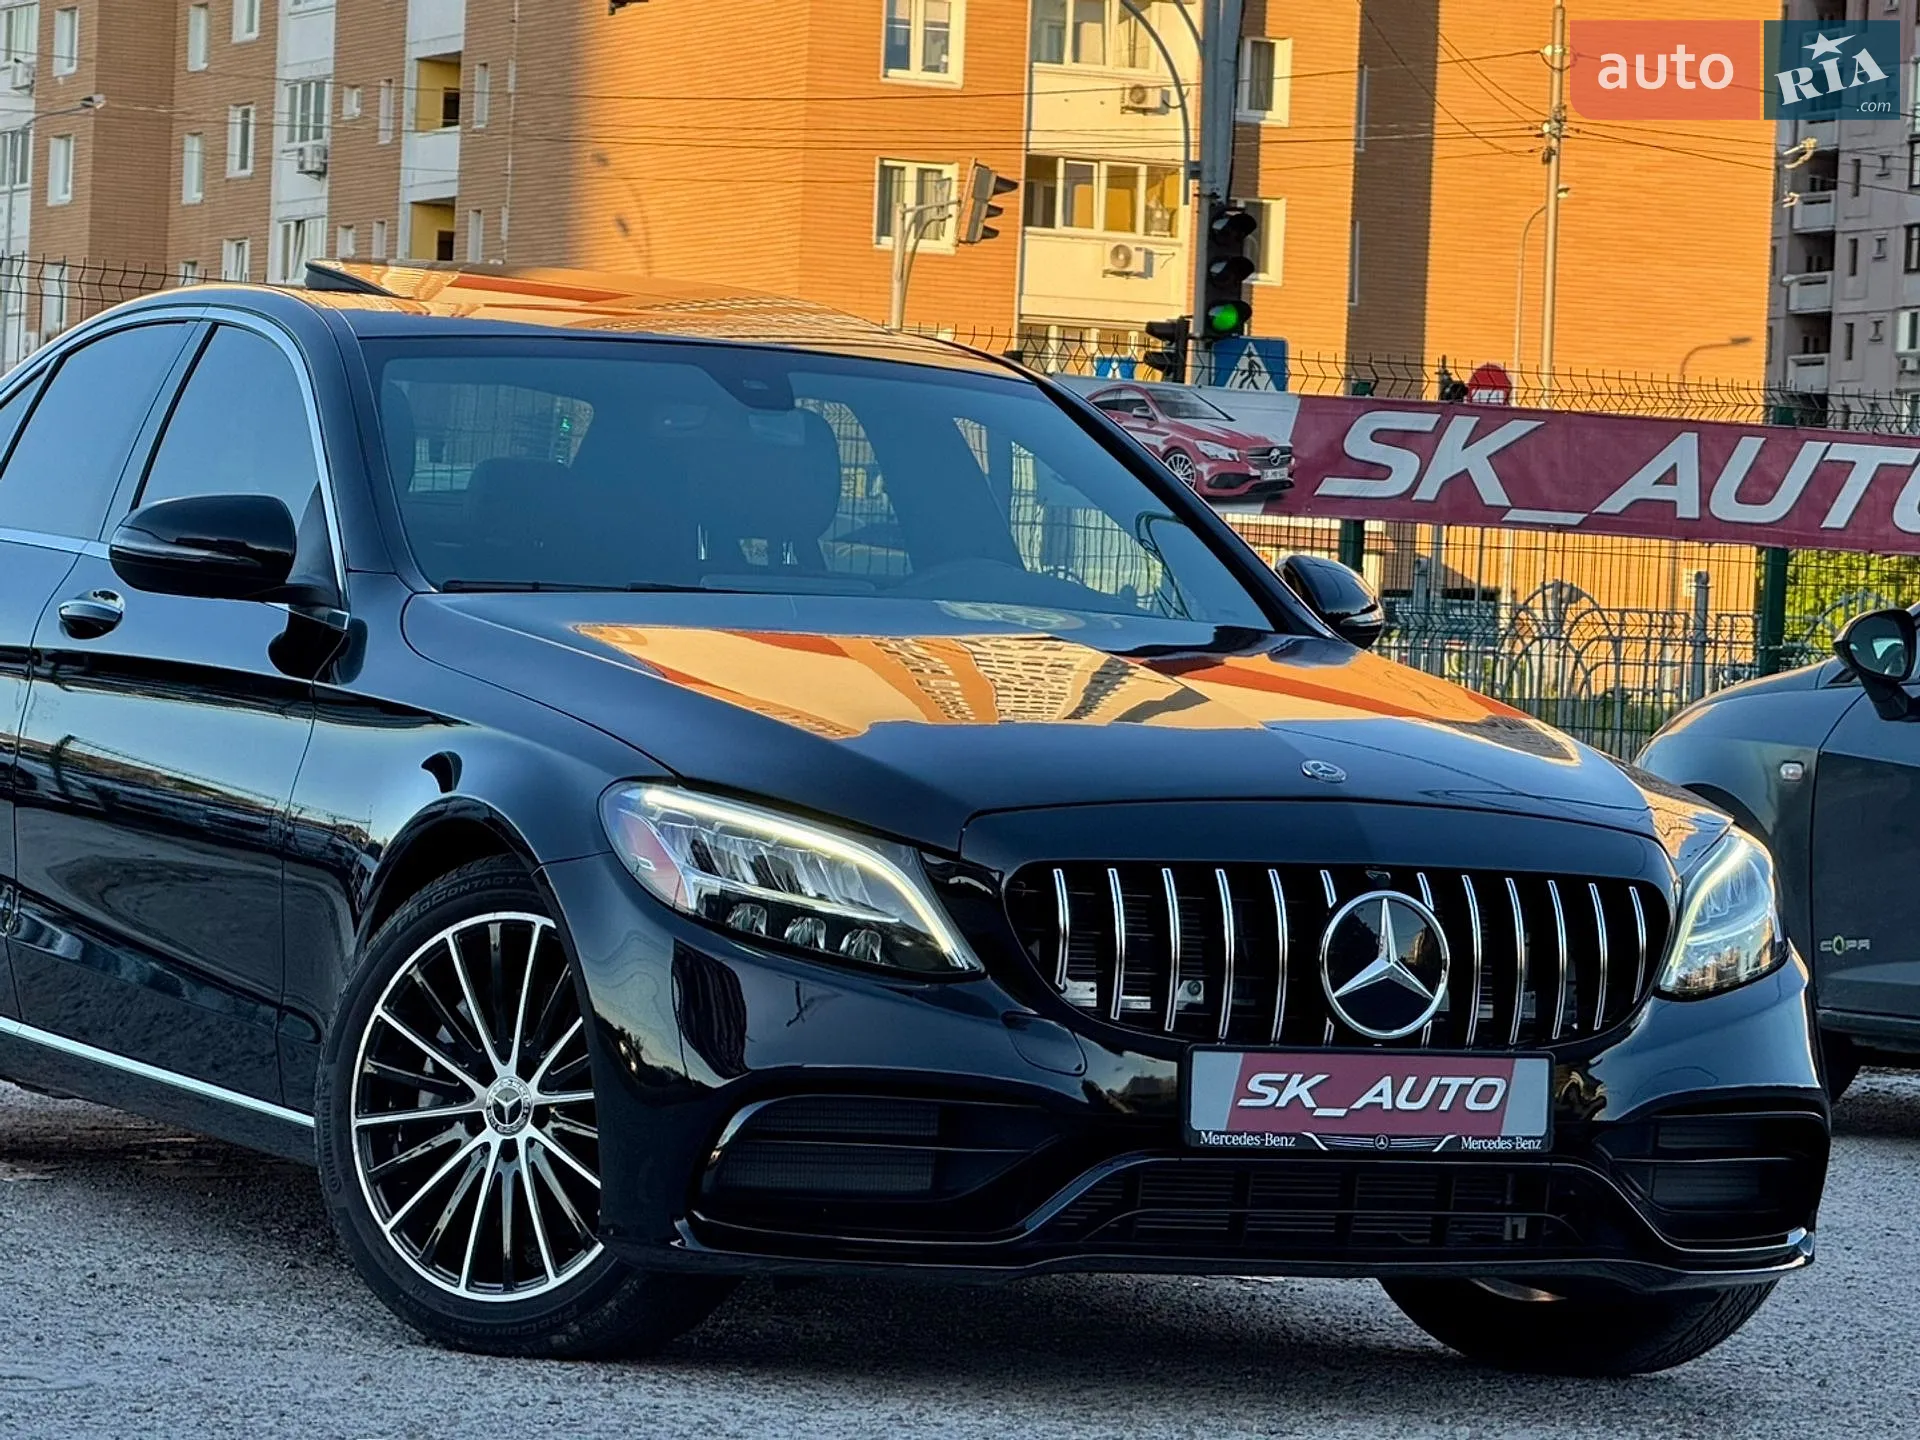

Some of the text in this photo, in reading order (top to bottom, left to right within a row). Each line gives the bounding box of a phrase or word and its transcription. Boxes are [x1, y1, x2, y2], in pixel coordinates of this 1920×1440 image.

[1314, 410, 1920, 534] SK_AUT
[1237, 1072, 1509, 1118] SK_AUTO
[1200, 1131, 1297, 1148] Mercedes-Benz
[1461, 1136, 1542, 1151] Mercedes-Benz
